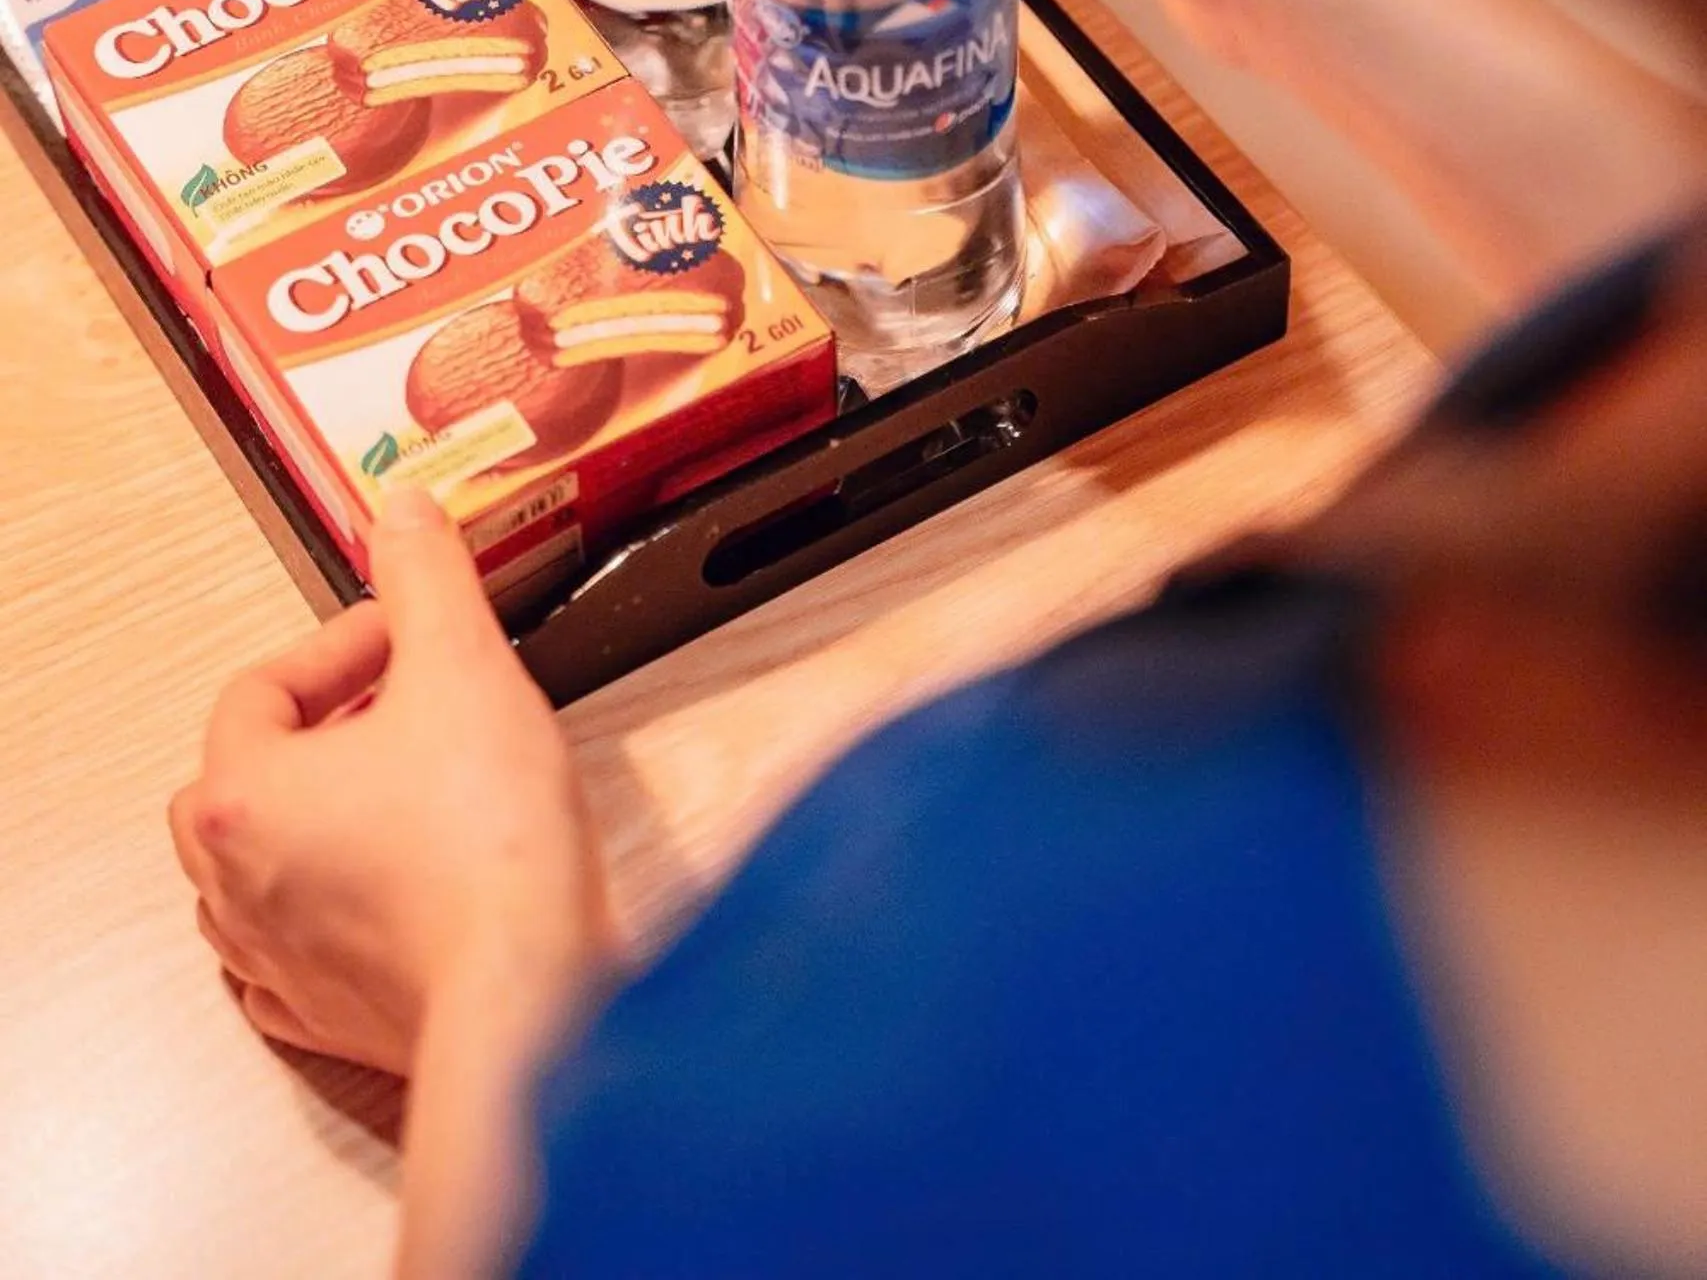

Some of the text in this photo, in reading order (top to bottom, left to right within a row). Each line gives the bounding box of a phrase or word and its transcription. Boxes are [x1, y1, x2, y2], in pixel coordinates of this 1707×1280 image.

[540, 69, 565, 94] 2
[803, 11, 1009, 108] AQUAFINA
[391, 140, 523, 218] ORION
[739, 328, 764, 354] 2
